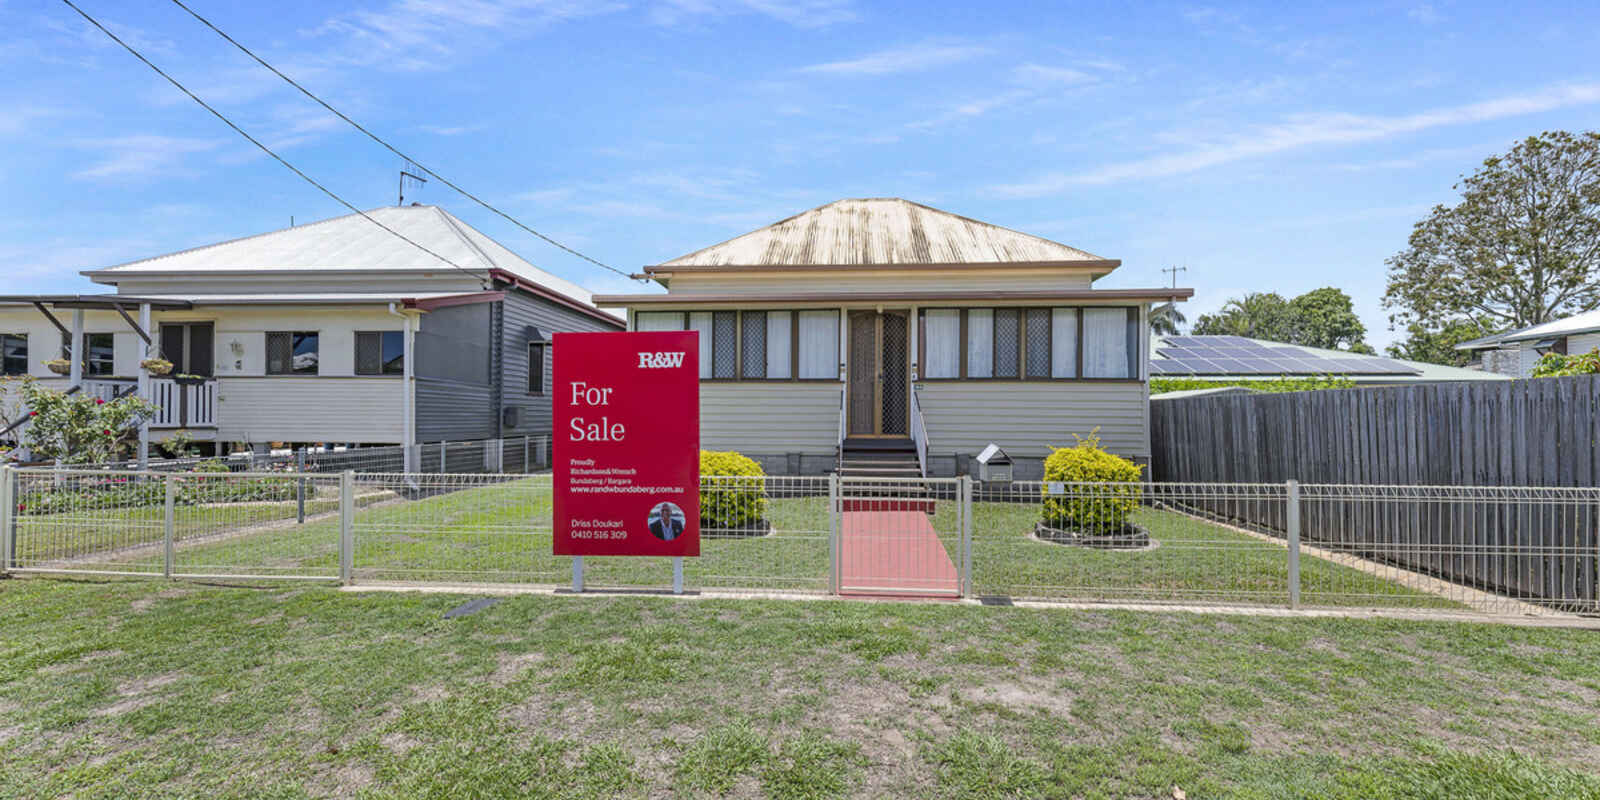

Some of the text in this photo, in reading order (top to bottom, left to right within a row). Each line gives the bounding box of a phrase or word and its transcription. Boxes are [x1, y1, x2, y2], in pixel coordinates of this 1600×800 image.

[637, 352, 686, 368] R&W
[569, 381, 613, 406] For
[569, 416, 625, 442] Sale
[570, 458, 595, 467] Proudly
[570, 486, 684, 495] www.randwbundaberg.com.au
[571, 519, 591, 528] Driss
[571, 530, 592, 539] 0410
[610, 530, 628, 539] 309
